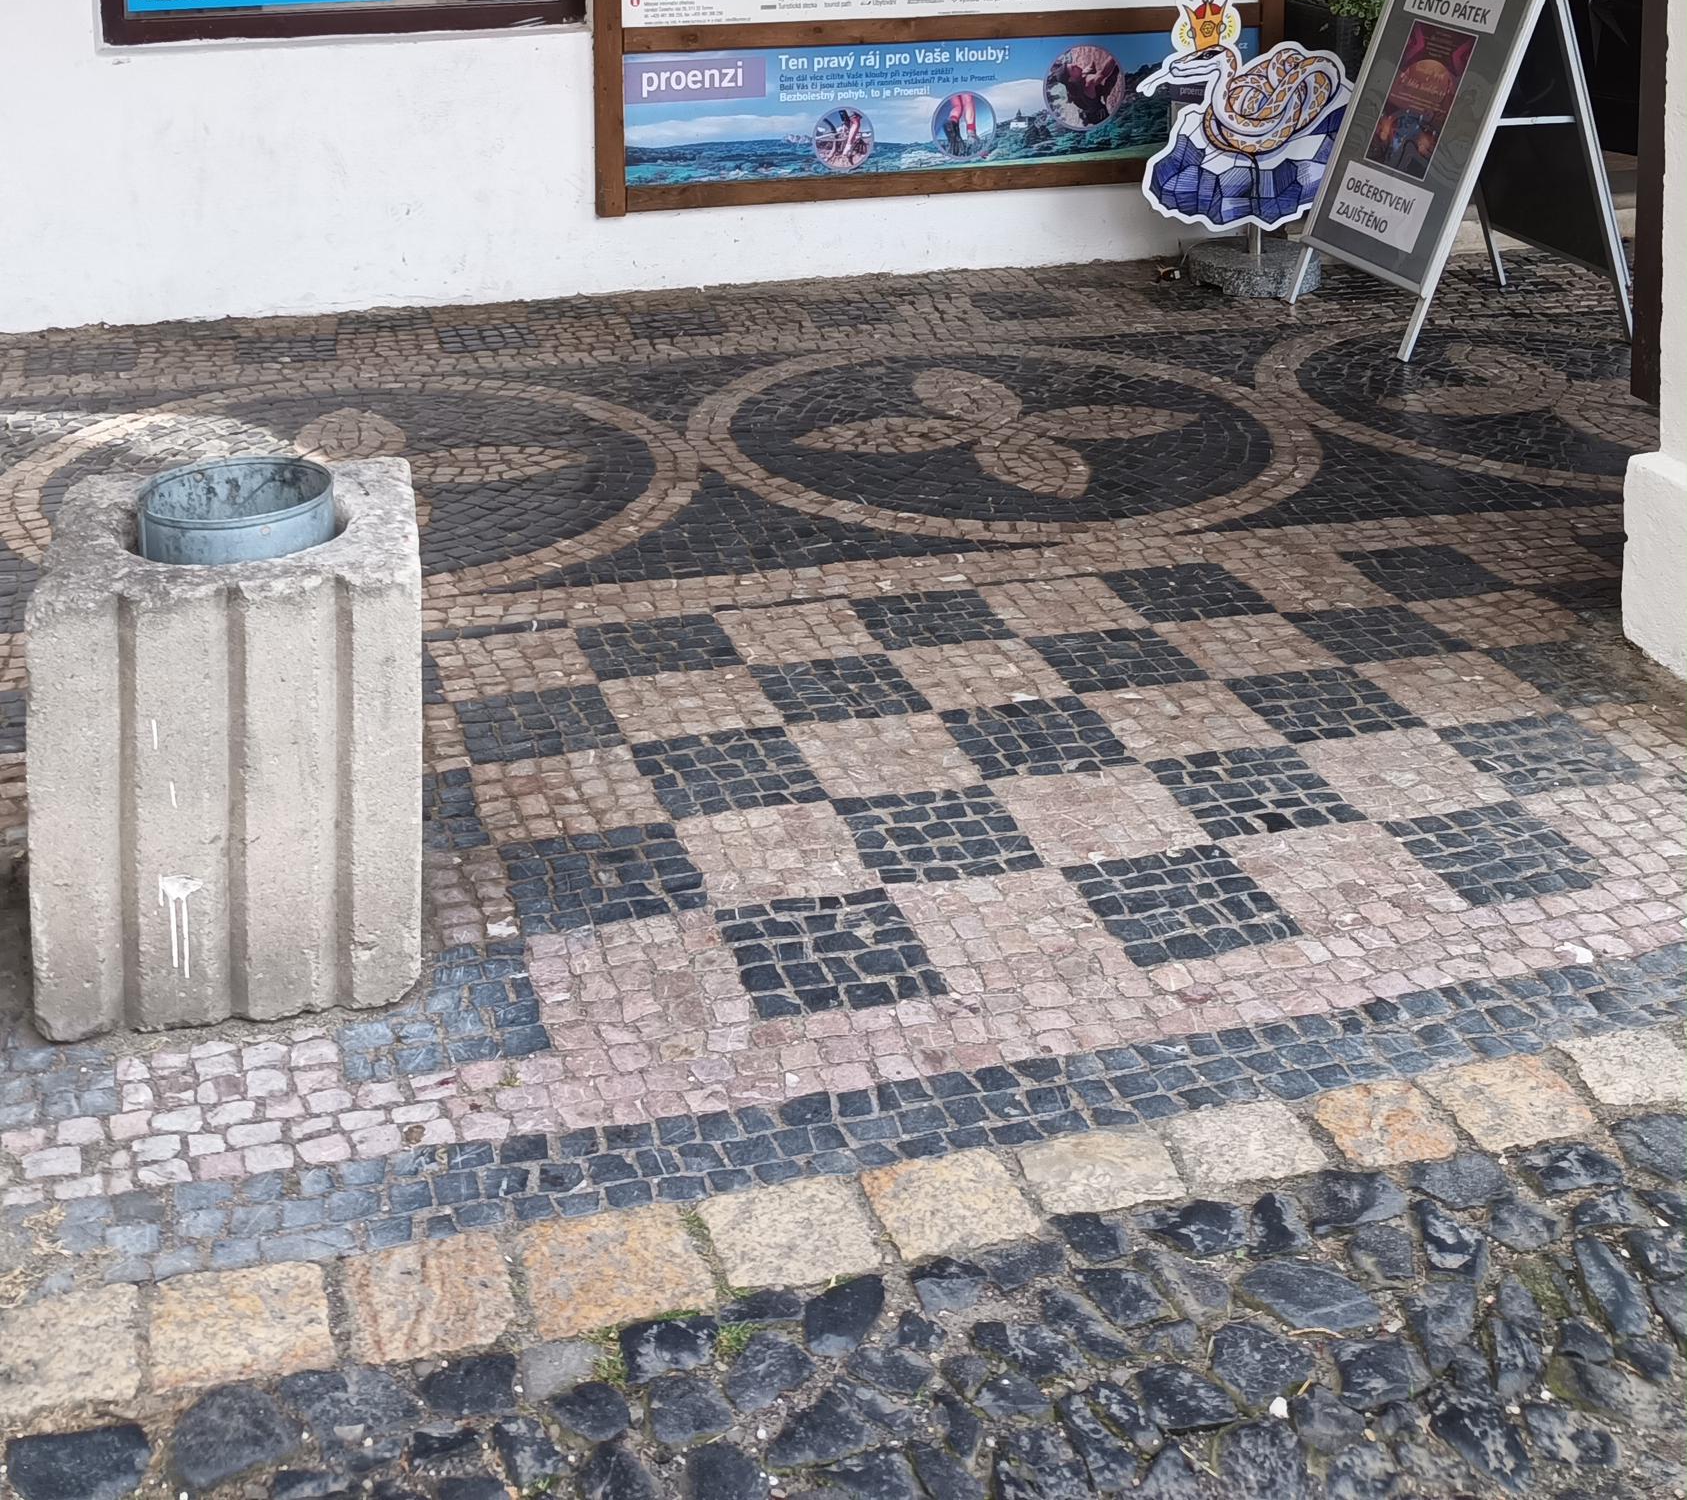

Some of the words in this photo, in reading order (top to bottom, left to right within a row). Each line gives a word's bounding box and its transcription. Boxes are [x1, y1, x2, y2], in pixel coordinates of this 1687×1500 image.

[1451, 0, 1491, 25] PÁTEK
[778, 55, 808, 70] Ten
[814, 52, 855, 72] pravý
[860, 51, 880, 69] ráj
[885, 53, 910, 68] pro
[915, 48, 950, 64] Vaše
[955, 46, 1010, 64] klouby!
[641, 60, 743, 98] proenzi
[779, 73, 794, 82] Čím
[796, 73, 808, 82] dál
[809, 73, 824, 81] více
[846, 71, 863, 80] Vaše
[865, 71, 888, 80] klouby
[890, 70, 900, 79] při
[779, 83, 794, 91] Bolí
[796, 82, 808, 90] Vás
[819, 81, 834, 90] jsou
[865, 79, 875, 88] při
[952, 75, 959, 84] je
[779, 90, 834, 102] Bezbolestný
[837, 89, 868, 101] pohyb,
[871, 88, 880, 98] to
[882, 88, 891, 98] je
[894, 86, 930, 97] Proenzi!
[1179, 87, 1204, 96] proenz
[1346, 177, 1416, 215] OBČERSTVENÍ
[1336, 201, 1388, 234] ZAJIŠTĚNO
